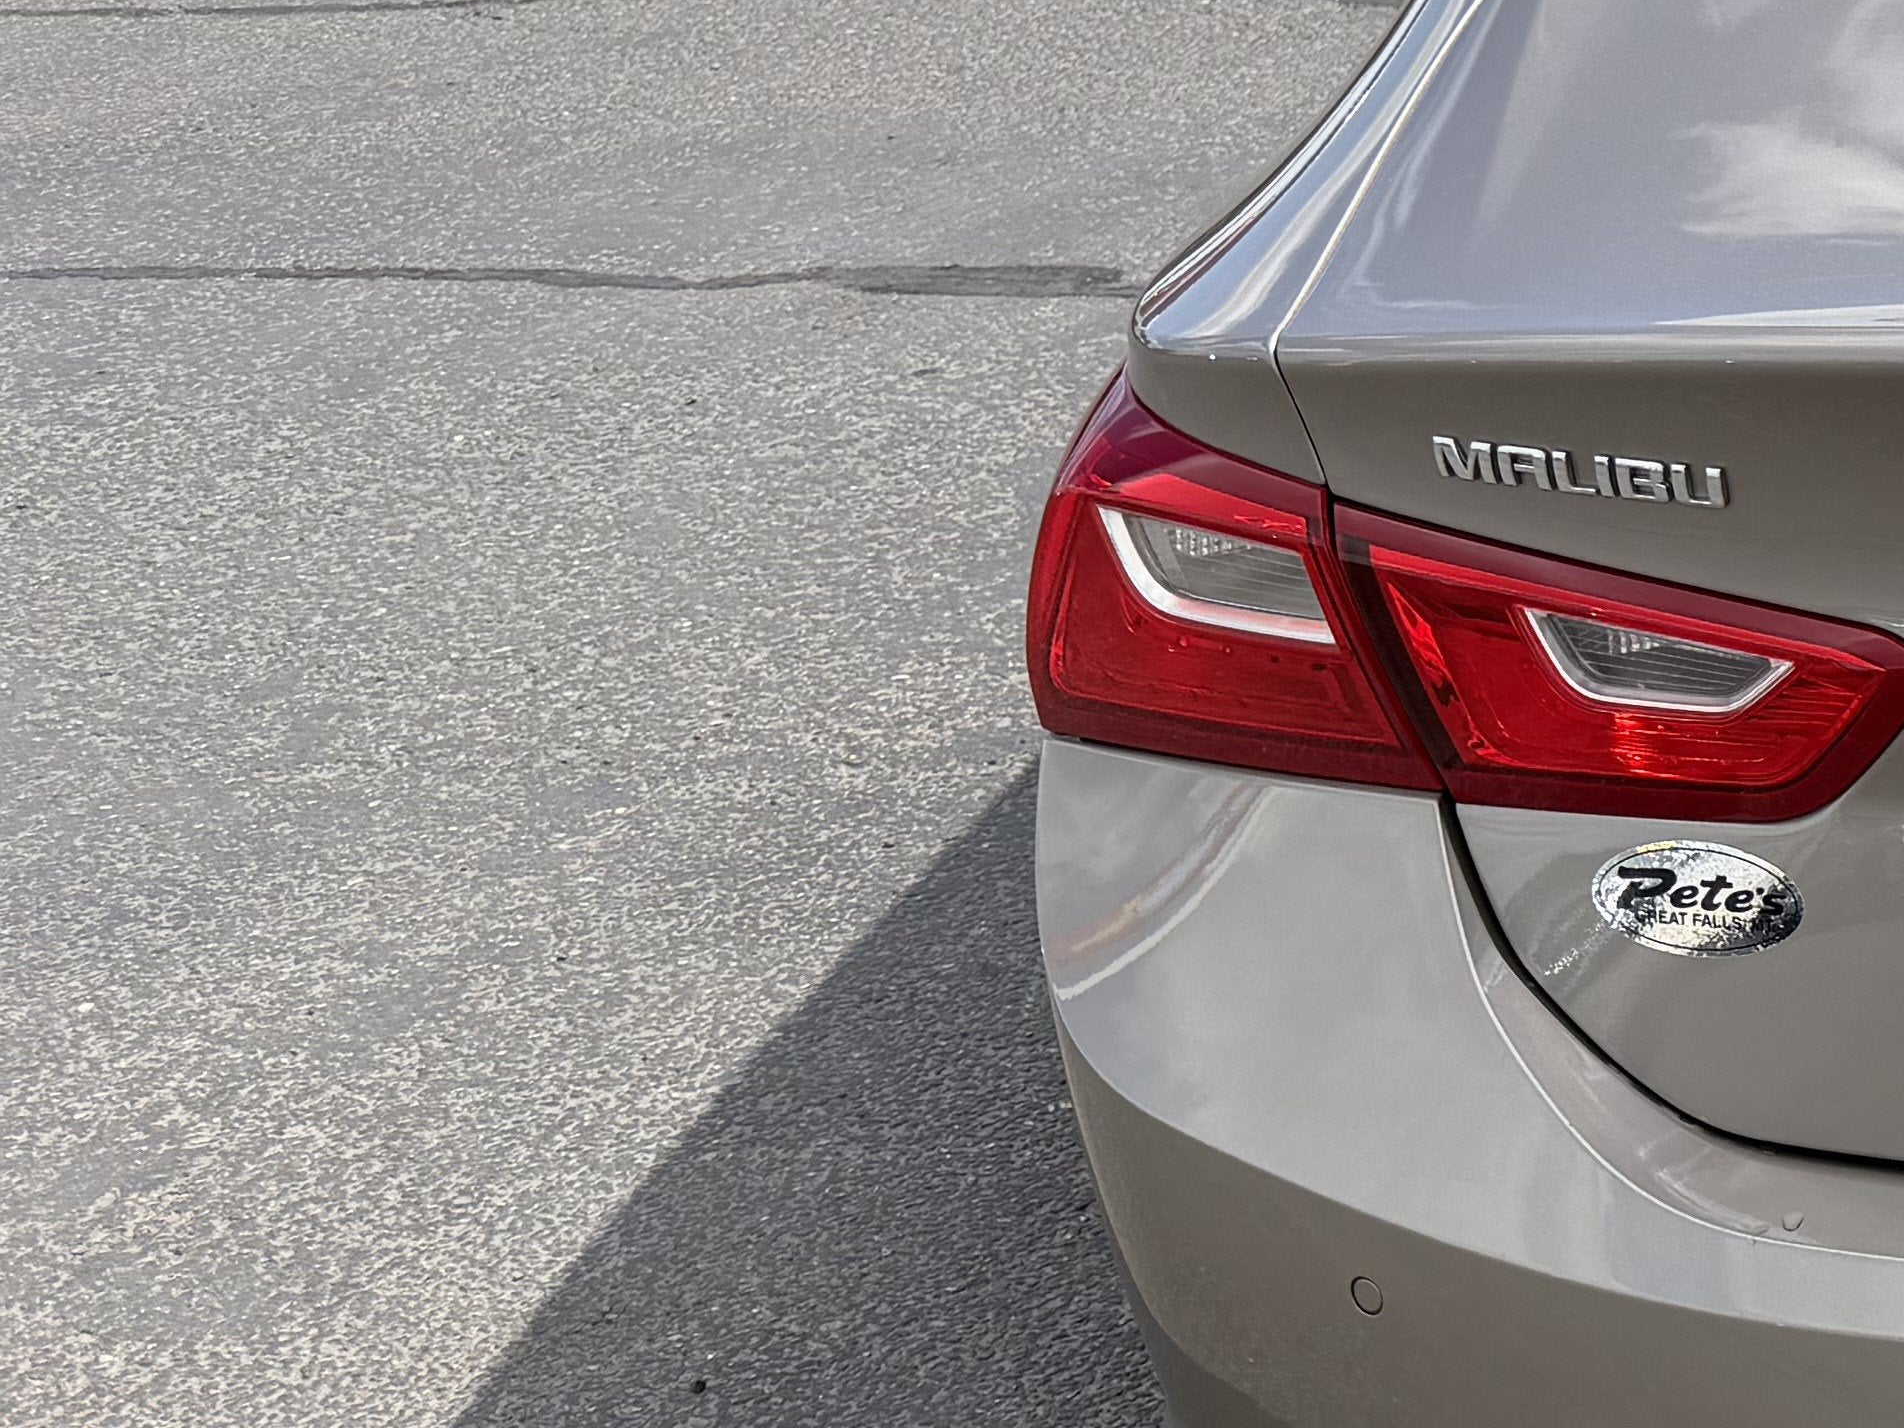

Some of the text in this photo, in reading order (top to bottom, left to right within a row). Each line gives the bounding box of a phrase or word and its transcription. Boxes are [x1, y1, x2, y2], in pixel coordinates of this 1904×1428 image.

[1432, 435, 1730, 509] MALIBU
[1617, 866, 1786, 915] Pete's
[1635, 909, 1688, 925] GREAT
